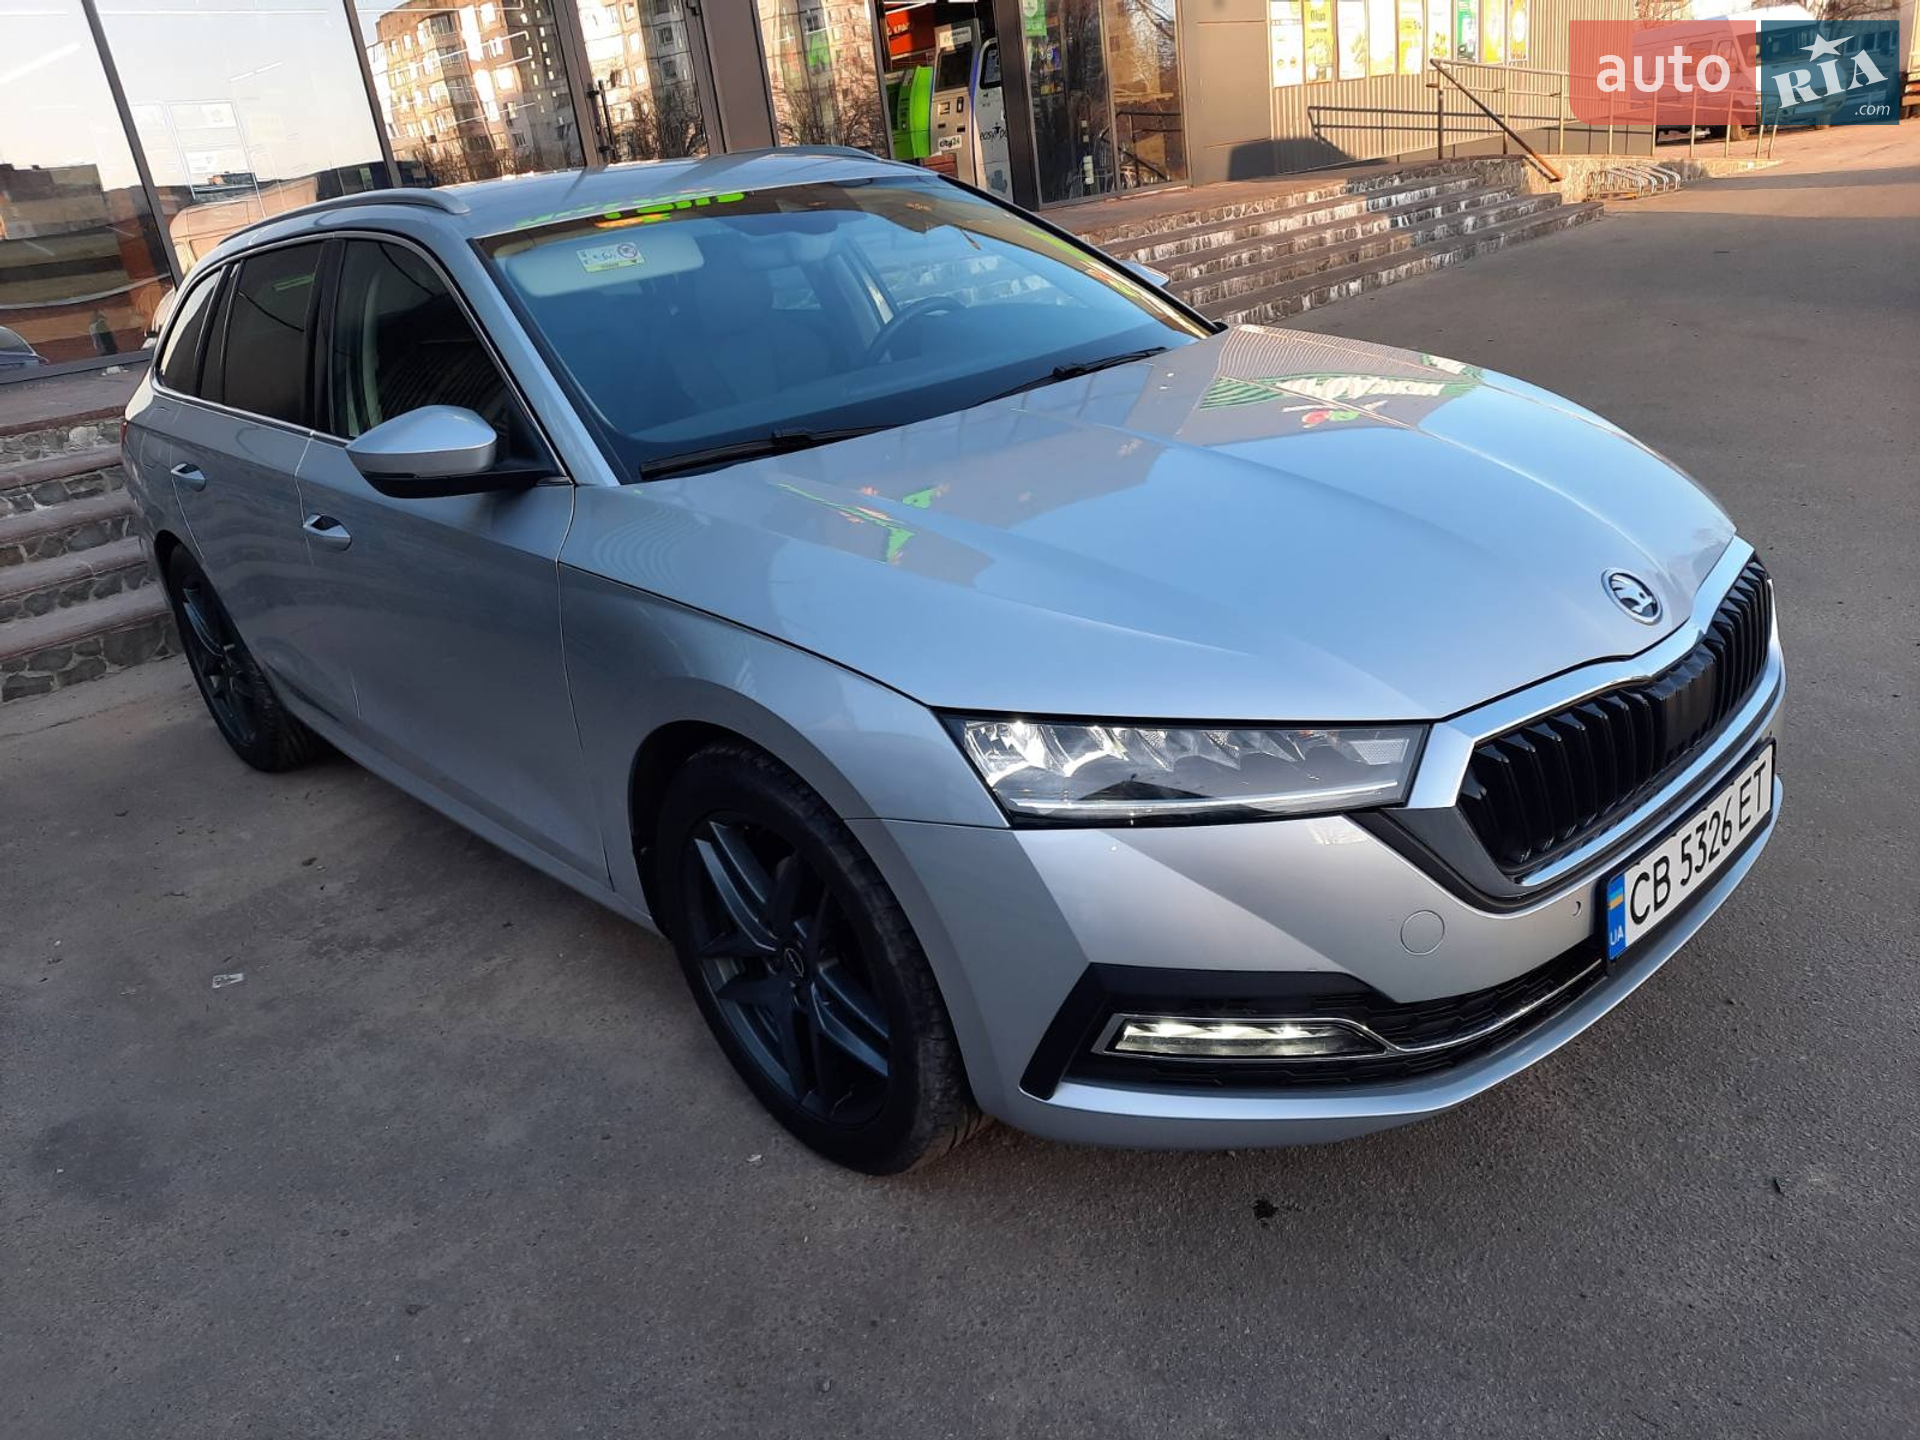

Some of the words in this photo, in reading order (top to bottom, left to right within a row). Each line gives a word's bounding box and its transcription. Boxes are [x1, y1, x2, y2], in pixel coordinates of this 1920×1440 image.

[939, 136, 960, 149] city24
[1629, 855, 1671, 926] CB
[1680, 795, 1733, 887] 5326
[1738, 760, 1767, 833] ET
[1609, 926, 1624, 946] UA
